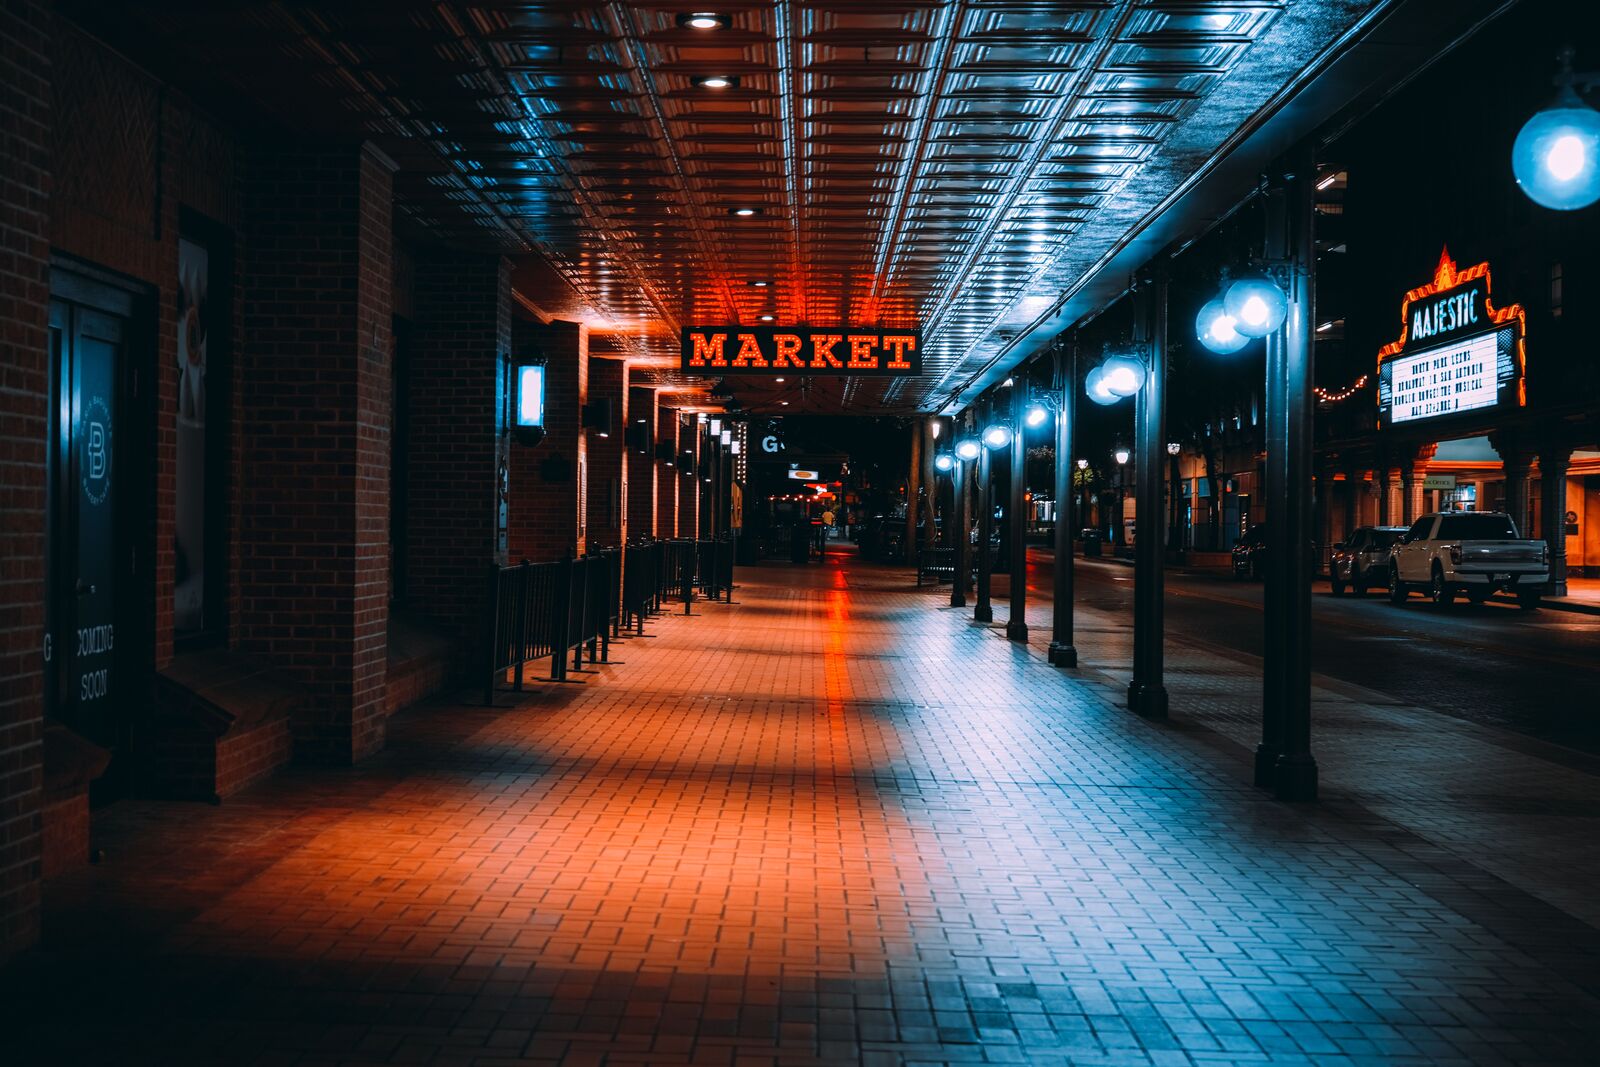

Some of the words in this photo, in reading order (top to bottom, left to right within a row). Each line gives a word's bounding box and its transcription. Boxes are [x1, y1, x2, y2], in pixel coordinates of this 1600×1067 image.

[1412, 289, 1478, 341] MAJESTIC
[689, 333, 916, 369] MARKET
[1433, 356, 1447, 370] PARK
[1451, 350, 1471, 366] LEXUS
[1440, 370, 1451, 382] SAN
[1455, 362, 1482, 379] ANTONIO
[1455, 378, 1482, 394] MUSICAL
[81, 669, 108, 701] SOON
